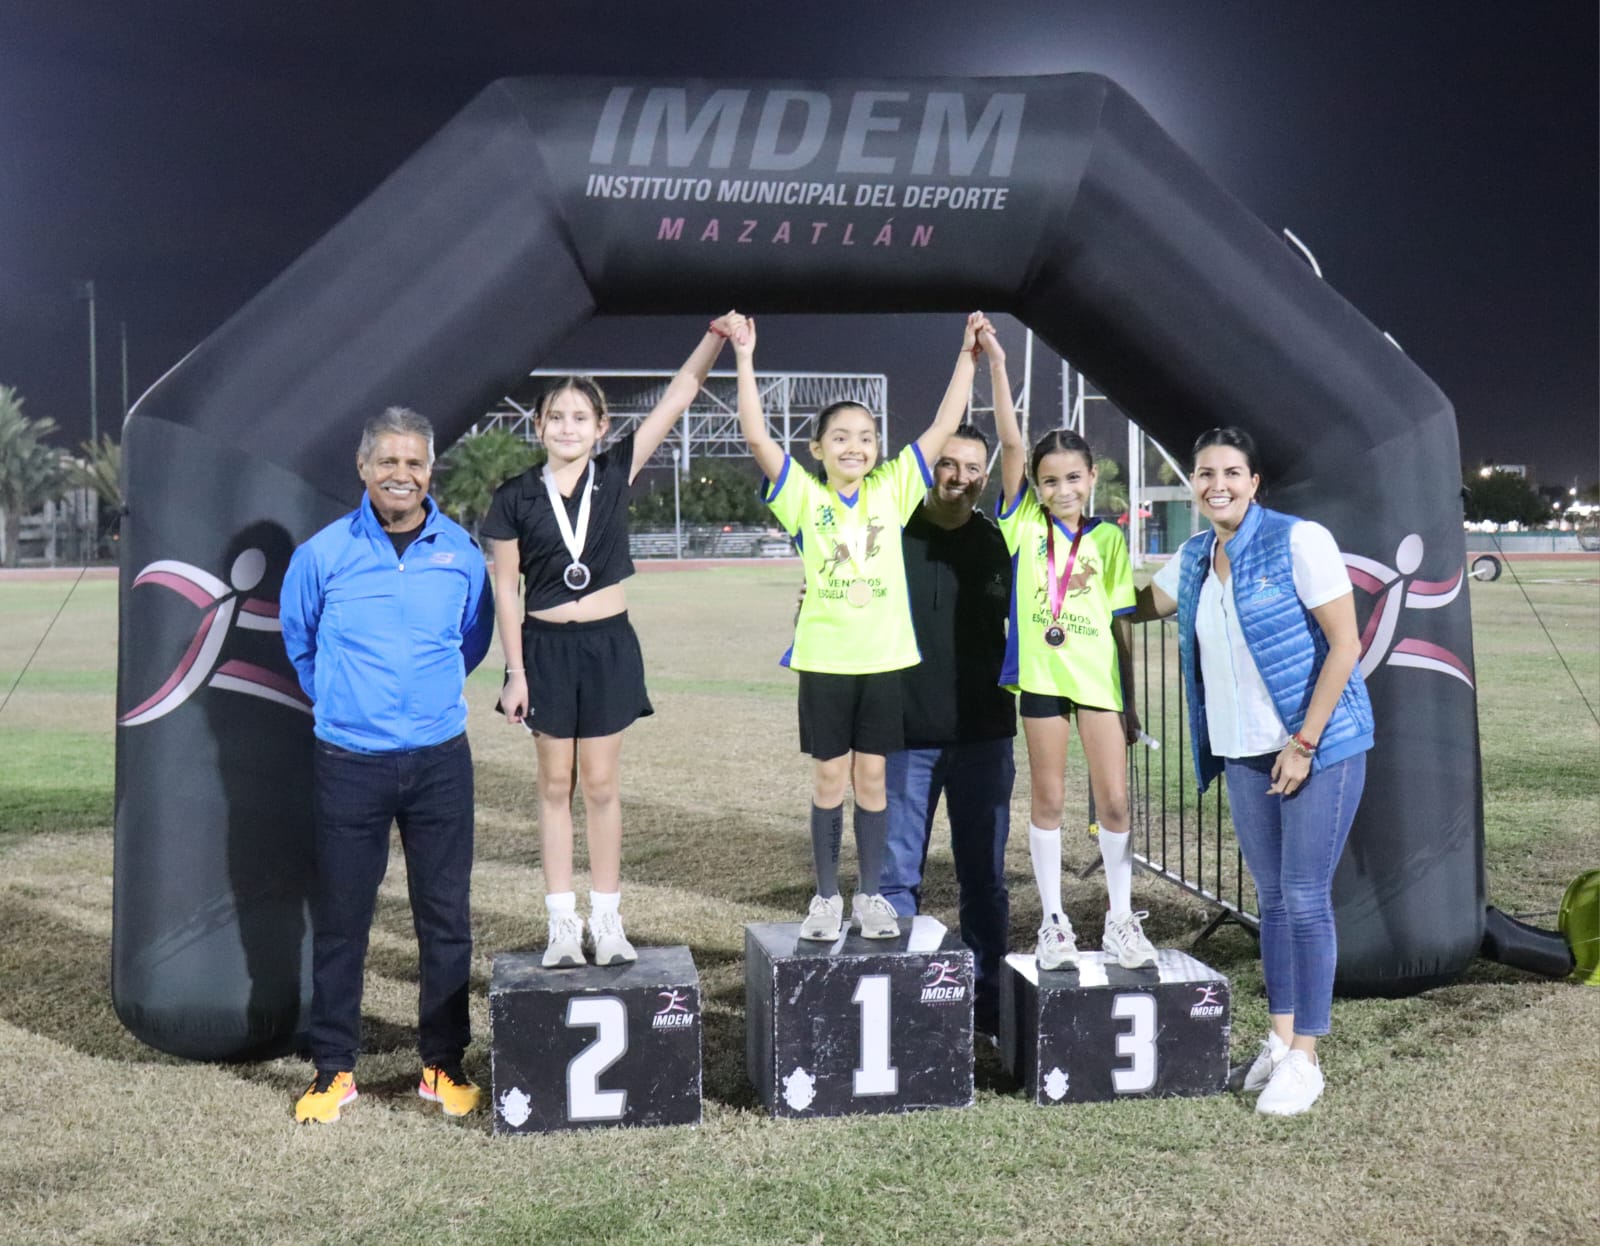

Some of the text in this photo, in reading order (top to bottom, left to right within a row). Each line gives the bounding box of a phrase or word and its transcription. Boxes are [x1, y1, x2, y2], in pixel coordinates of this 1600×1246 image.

[588, 86, 1027, 178] IMDEM
[586, 173, 1009, 211] INSTITUTO MUNICIPAL DEL DEPORTE
[657, 216, 935, 248] MAZATLÁN
[827, 577, 881, 588] VENOS
[1039, 606, 1091, 625] VEADOS
[827, 816, 841, 863] adidas
[920, 986, 966, 1000] IMDEM
[652, 1013, 694, 1026] IMDEM
[1190, 1005, 1224, 1017] IMDEM
[851, 974, 899, 1097] 1
[1111, 993, 1158, 1094] 3
[565, 996, 629, 1122] 2
